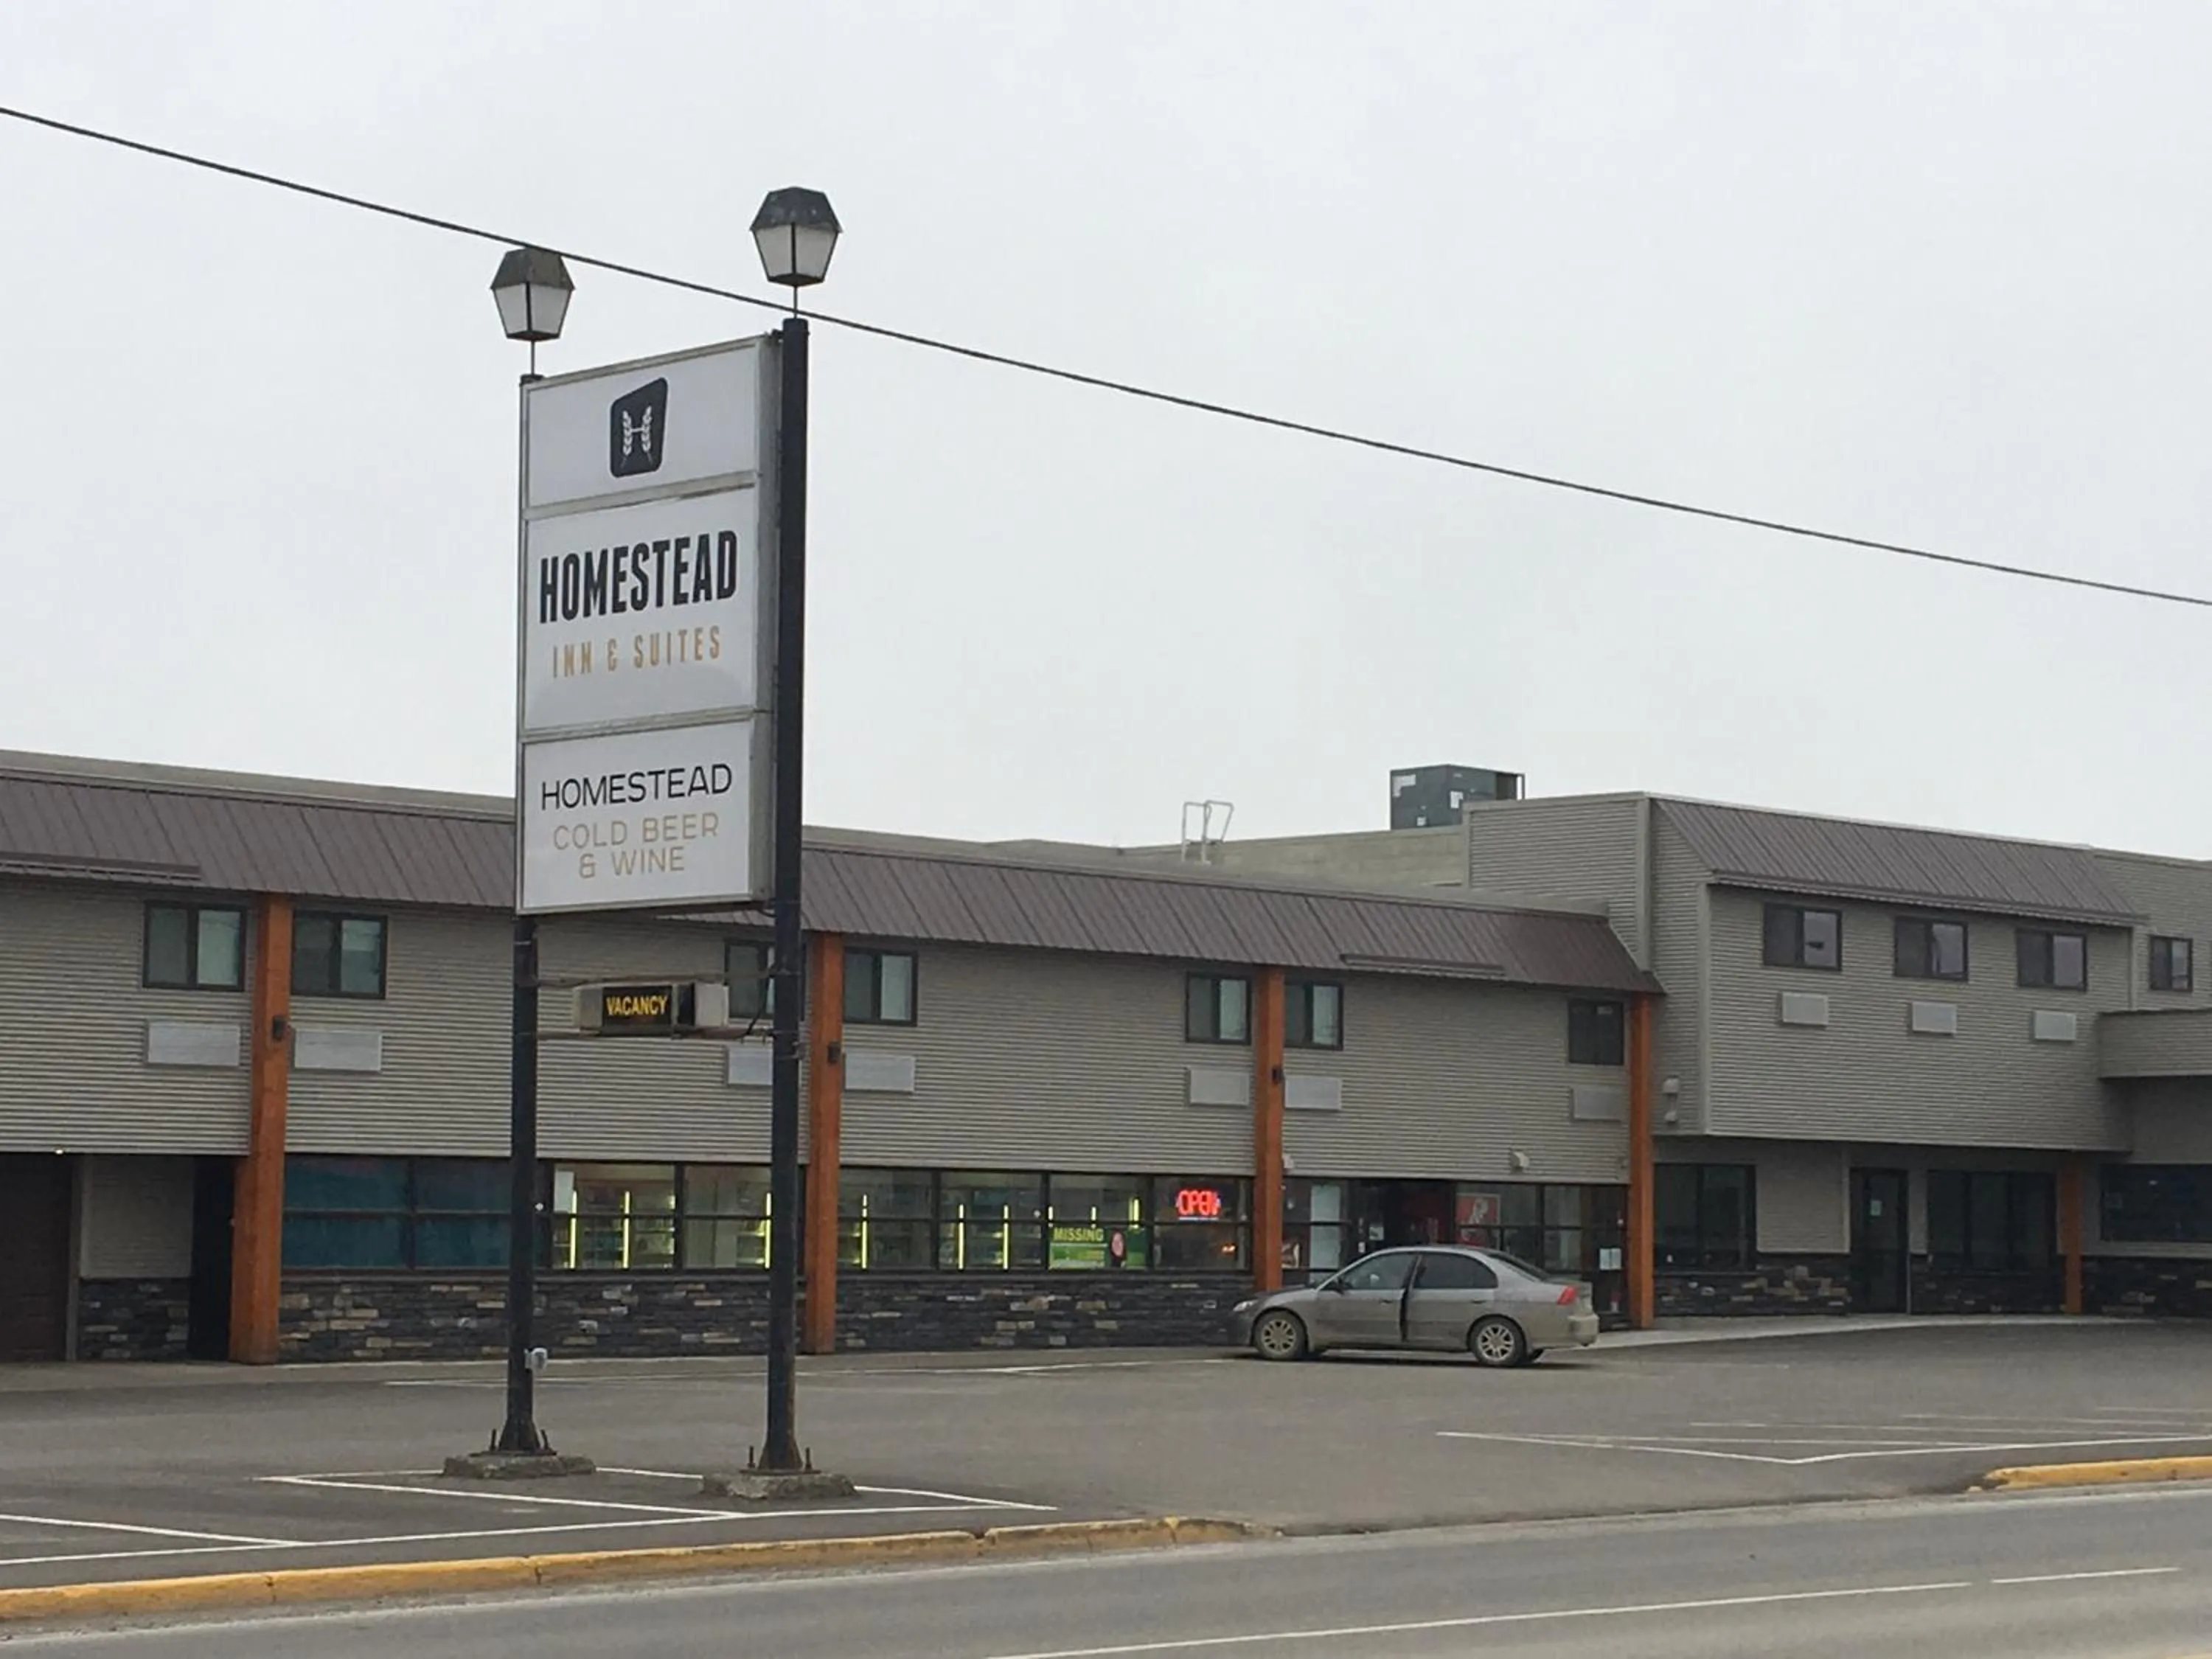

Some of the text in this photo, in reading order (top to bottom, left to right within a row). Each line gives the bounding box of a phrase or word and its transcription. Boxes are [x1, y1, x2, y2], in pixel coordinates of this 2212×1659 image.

[540, 530, 738, 624] HOMESTEAD
[553, 626, 721, 678] INN & SUITES
[541, 763, 732, 810] HOMESTEAD
[554, 812, 720, 851] COLD BEER
[579, 846, 685, 879] & WINE
[605, 995, 669, 1017] VACANCY
[1178, 1189, 1219, 1216] OPEN
[1053, 1227, 1104, 1242] MISSING
